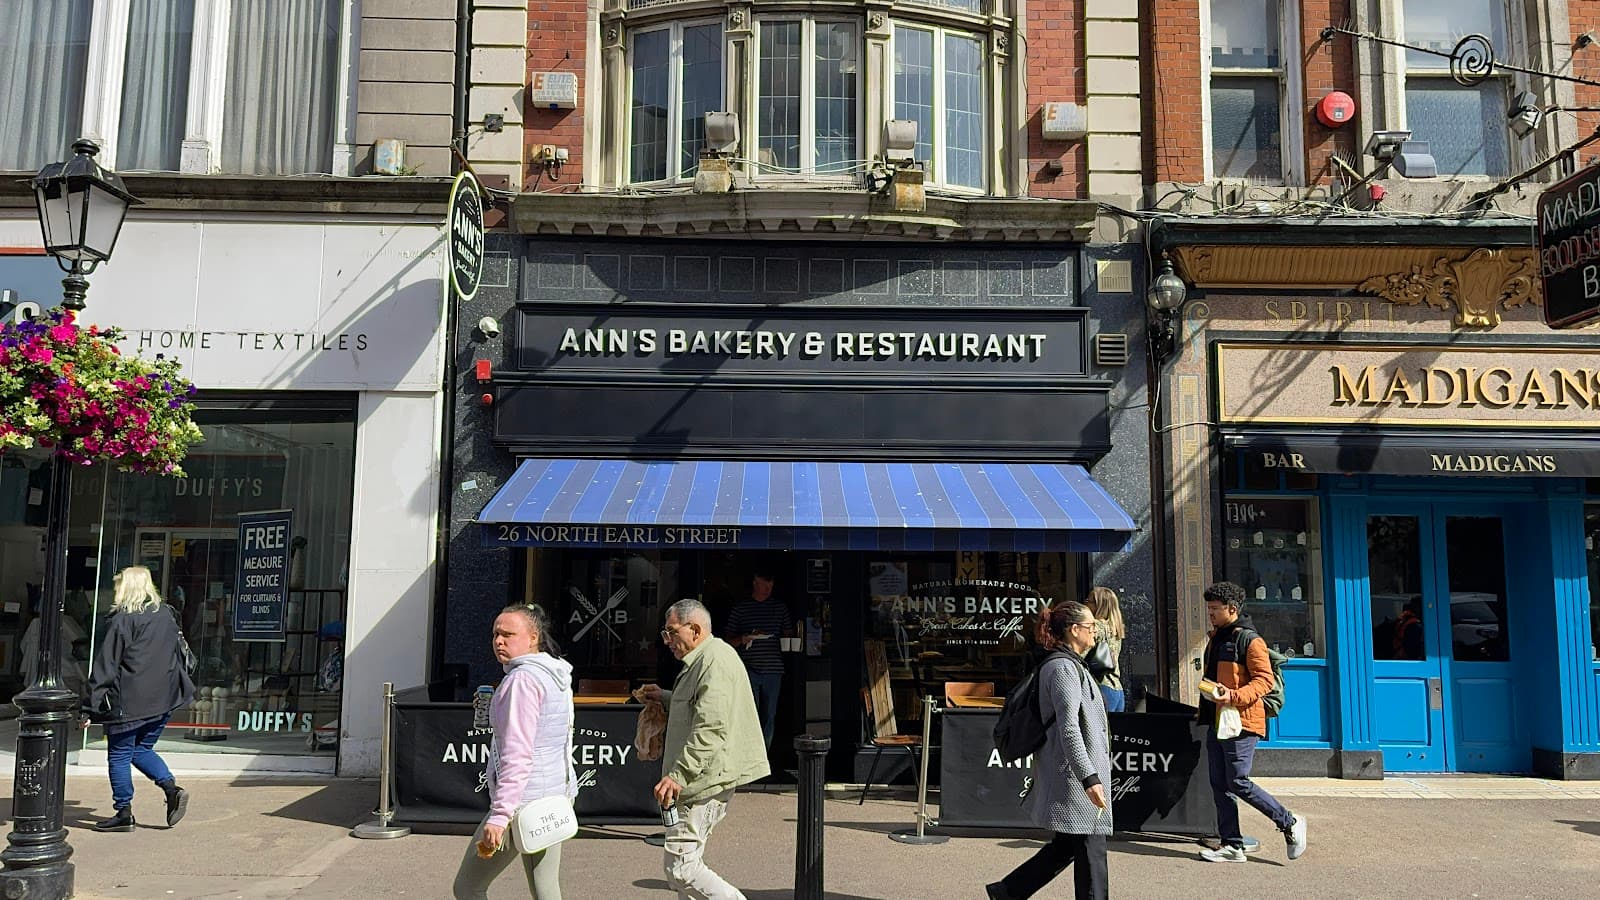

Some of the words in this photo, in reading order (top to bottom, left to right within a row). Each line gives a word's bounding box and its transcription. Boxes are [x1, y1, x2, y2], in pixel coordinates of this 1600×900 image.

[534, 74, 544, 89] E
[1047, 104, 1056, 120] E
[453, 206, 481, 256] ANN'S
[457, 241, 476, 268] BAKERY
[1264, 300, 1396, 328] SPIRIT
[139, 330, 211, 350] HOME
[237, 332, 368, 351] TEXTILES
[559, 327, 657, 353] ANN'S
[669, 329, 797, 356] BAKERY
[804, 331, 825, 356] &
[836, 332, 1047, 358] RESTAURANT
[1333, 363, 1600, 405] MADIGAN
[1261, 452, 1306, 469] BAR
[1430, 454, 1557, 473] MADIGANS
[174, 477, 264, 497] DUFFY'S
[244, 525, 286, 550] FREE
[497, 524, 520, 542] 26
[524, 525, 598, 543] NORTH
[604, 527, 660, 544] EARL
[664, 528, 742, 545] STREET
[243, 556, 283, 570] MEASURE
[245, 574, 280, 588] SERVICE
[911, 578, 953, 591] NATURAL
[954, 578, 1005, 588] HOMEMADE
[1008, 581, 1033, 592] FOOD
[240, 594, 252, 603] FOR
[253, 593, 276, 602] CURTAINS
[891, 596, 956, 614] ANN'S
[964, 597, 1053, 614] BAKERY
[251, 605, 271, 614] BLINDS
[568, 609, 583, 624] A
[614, 609, 629, 624] B
[993, 615, 1024, 638] Coffee
[237, 710, 313, 733] DUFFY'S
[467, 728, 494, 737] NATU
[579, 728, 608, 738] FOOD
[1123, 735, 1151, 746] FOOD
[441, 742, 491, 763] ANN
[571, 744, 632, 765] KERY
[1110, 752, 1175, 773] KERY
[575, 768, 597, 792] ffee
[528, 824, 554, 839] TOTE
[553, 815, 570, 829] BAG
[539, 812, 556, 824] THE
